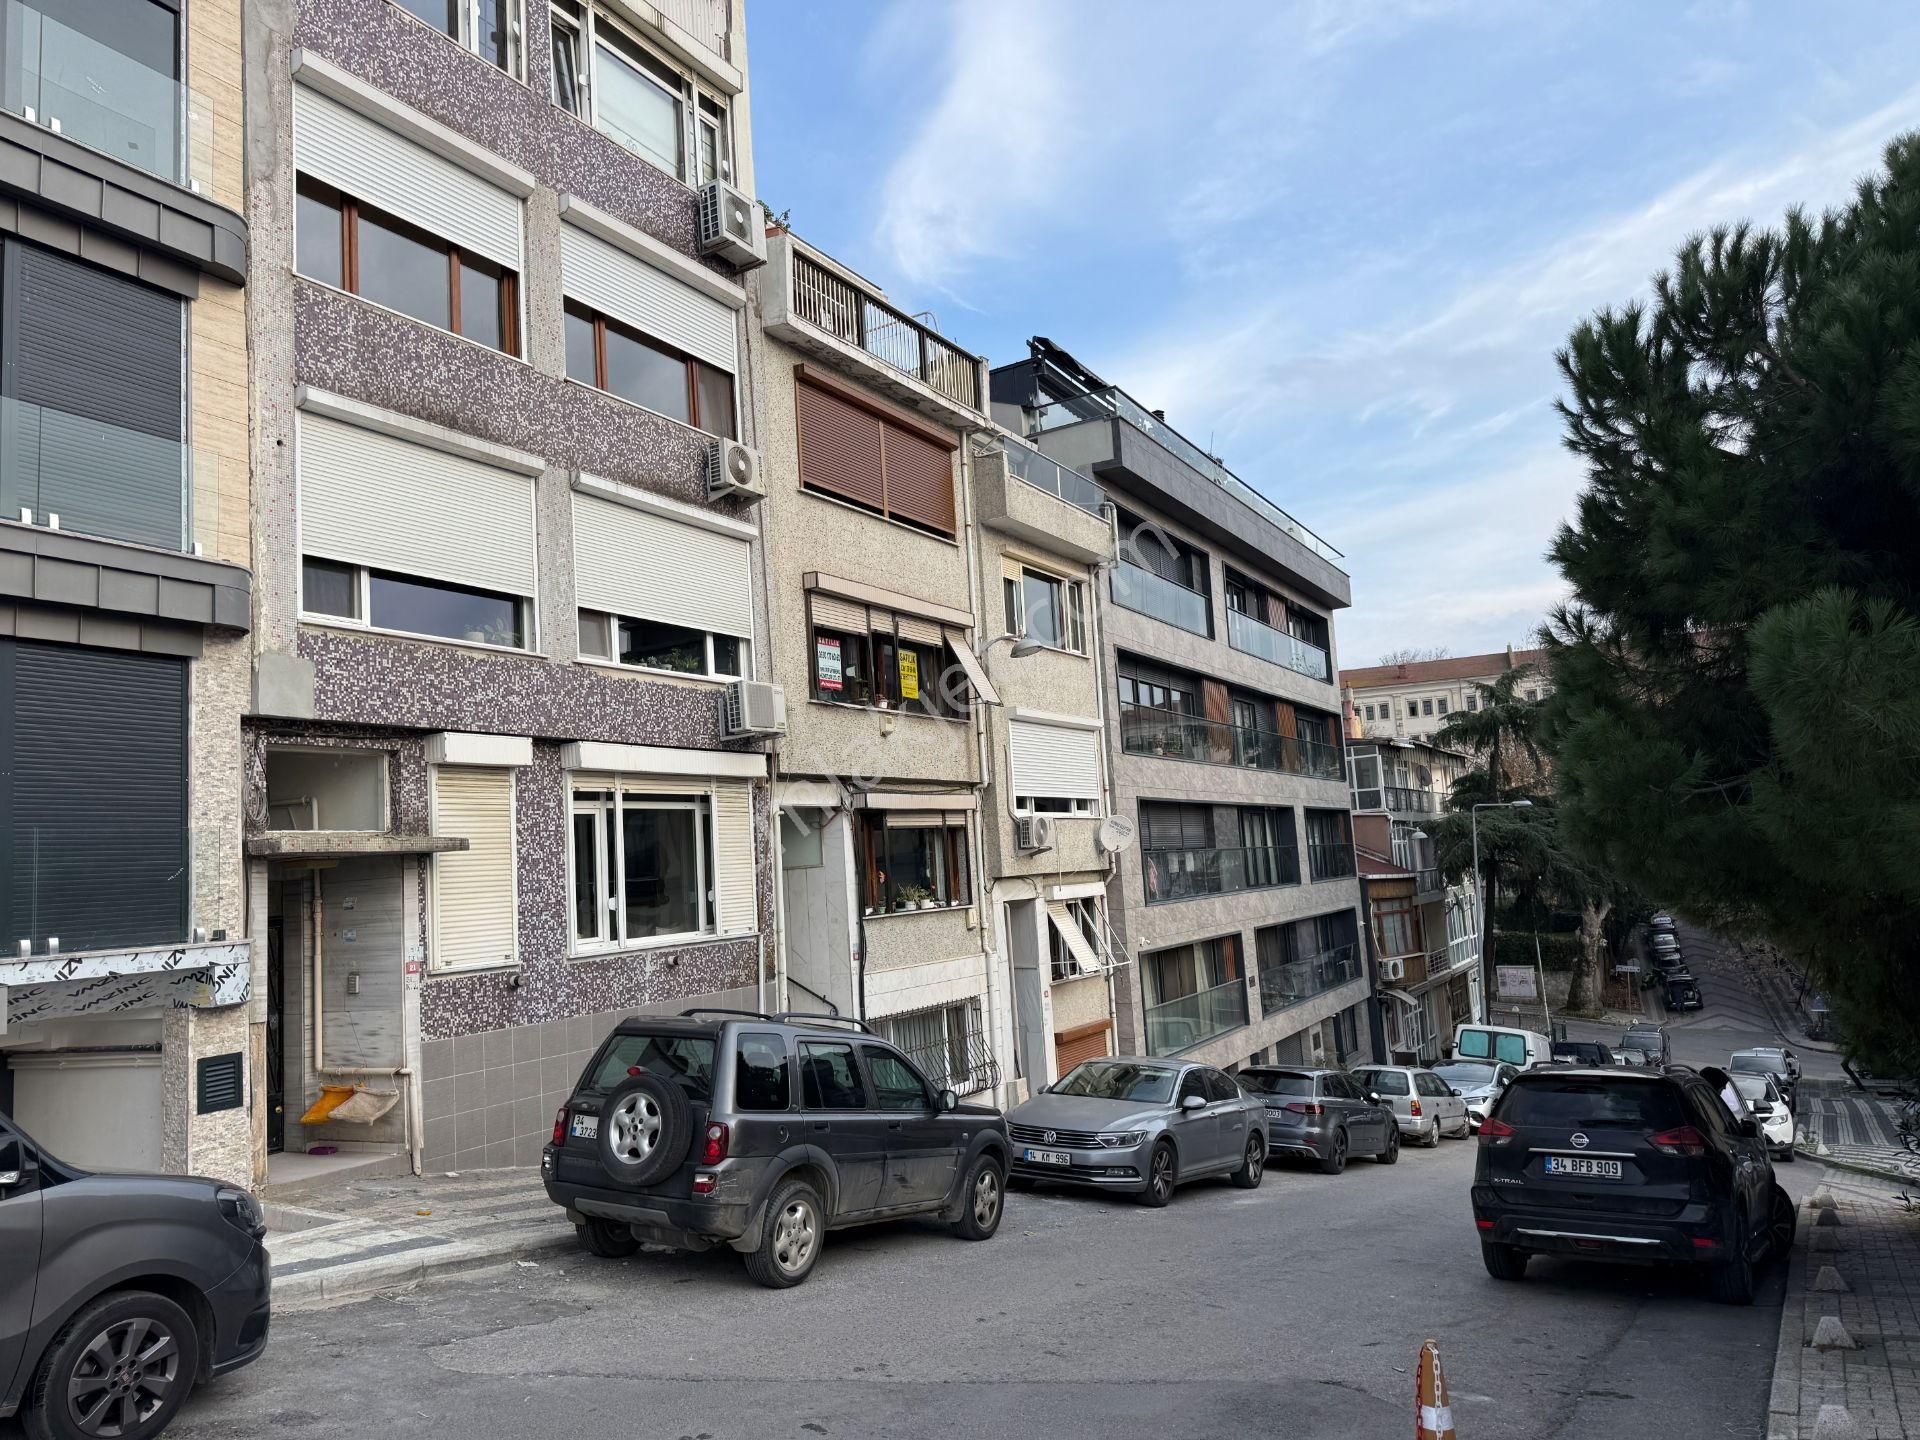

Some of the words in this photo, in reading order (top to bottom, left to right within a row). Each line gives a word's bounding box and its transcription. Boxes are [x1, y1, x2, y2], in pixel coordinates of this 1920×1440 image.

[818, 637, 840, 646] SATILIK
[576, 1116, 584, 1125] 34
[580, 1127, 597, 1137] 3723
[1552, 1158, 1567, 1171] 34
[1571, 1159, 1593, 1173] BFB
[1596, 1161, 1618, 1175] 909
[1494, 1177, 1524, 1185] X-TRAIL
